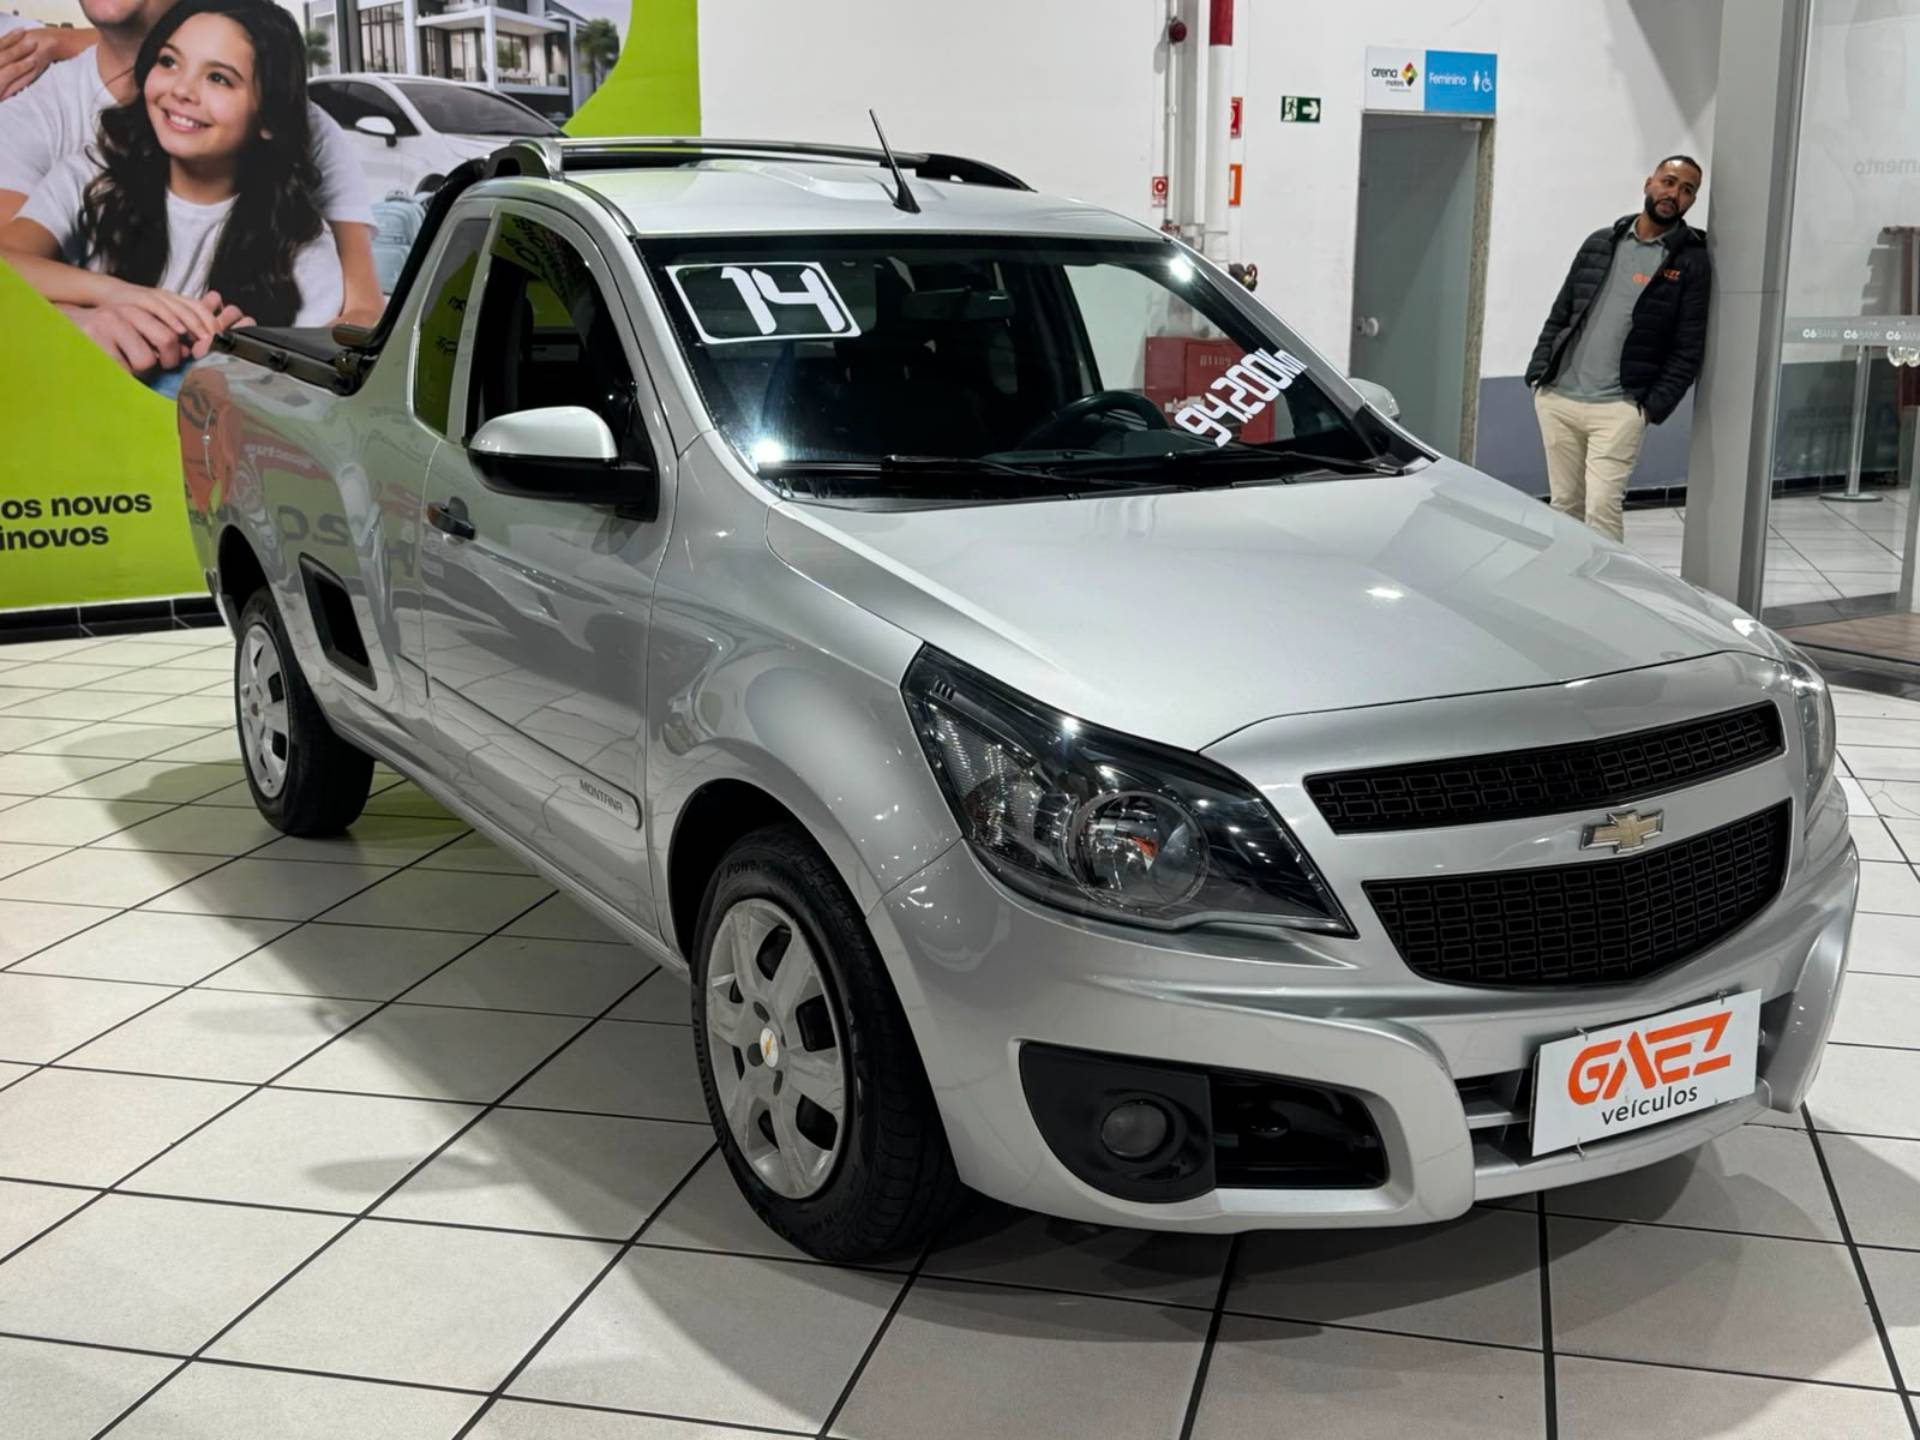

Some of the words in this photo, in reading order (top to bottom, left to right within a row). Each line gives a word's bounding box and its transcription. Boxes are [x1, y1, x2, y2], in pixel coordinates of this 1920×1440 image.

[1429, 72, 1467, 86] Feminino
[721, 266, 846, 335] 14
[51, 493, 152, 517] novos
[1568, 1011, 1733, 1106] GAEZ
[1601, 1086, 1698, 1125] veículos
